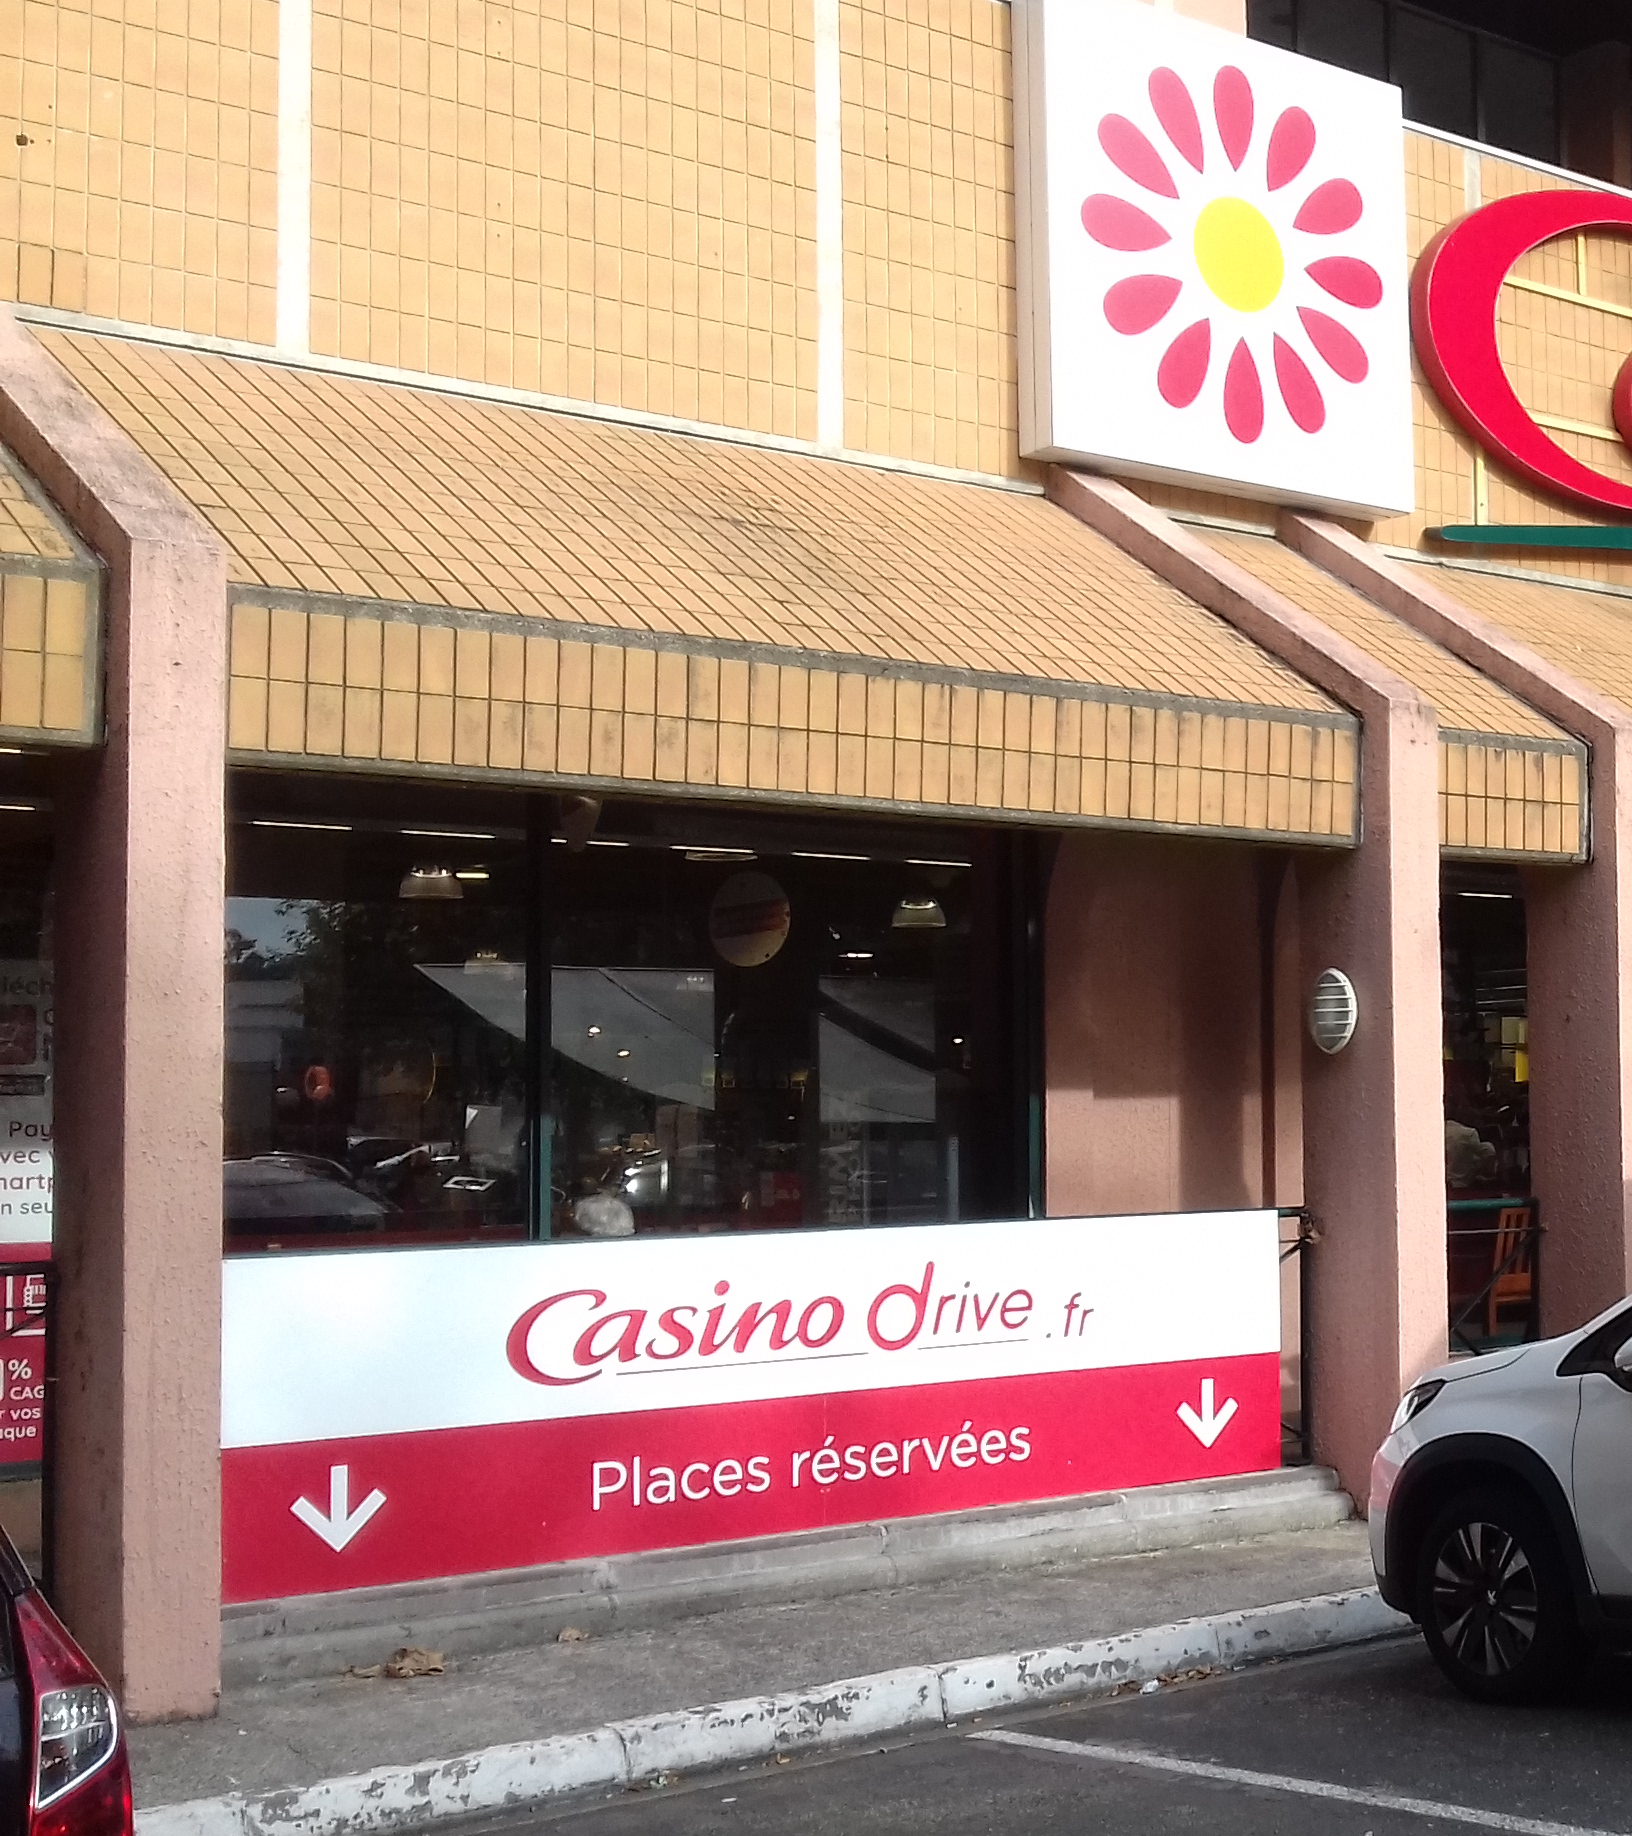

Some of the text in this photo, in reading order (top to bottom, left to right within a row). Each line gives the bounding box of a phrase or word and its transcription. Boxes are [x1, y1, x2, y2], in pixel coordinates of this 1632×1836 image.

[506, 1280, 845, 1386] Casino
[866, 1260, 1034, 1351] drive
[10, 1407, 42, 1421] vos
[591, 1419, 1032, 1511] Places réservées
